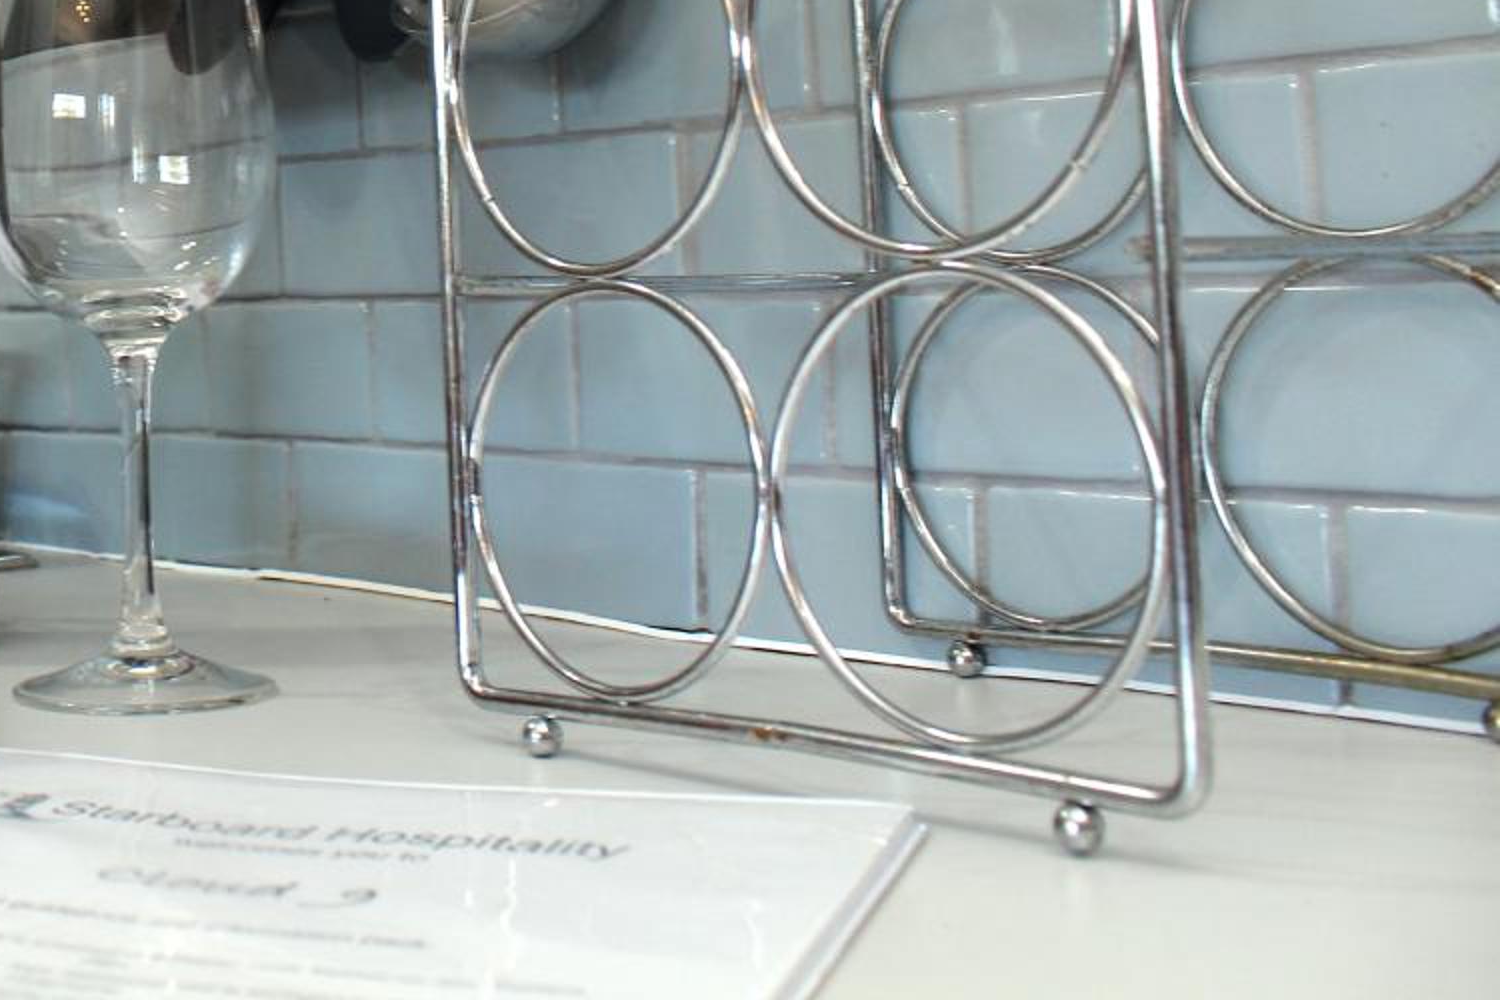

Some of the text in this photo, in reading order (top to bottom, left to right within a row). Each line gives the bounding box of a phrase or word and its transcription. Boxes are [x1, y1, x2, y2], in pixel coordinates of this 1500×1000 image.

[51, 799, 631, 862] Starboard Hospitality
[97, 864, 299, 898] Cloud
